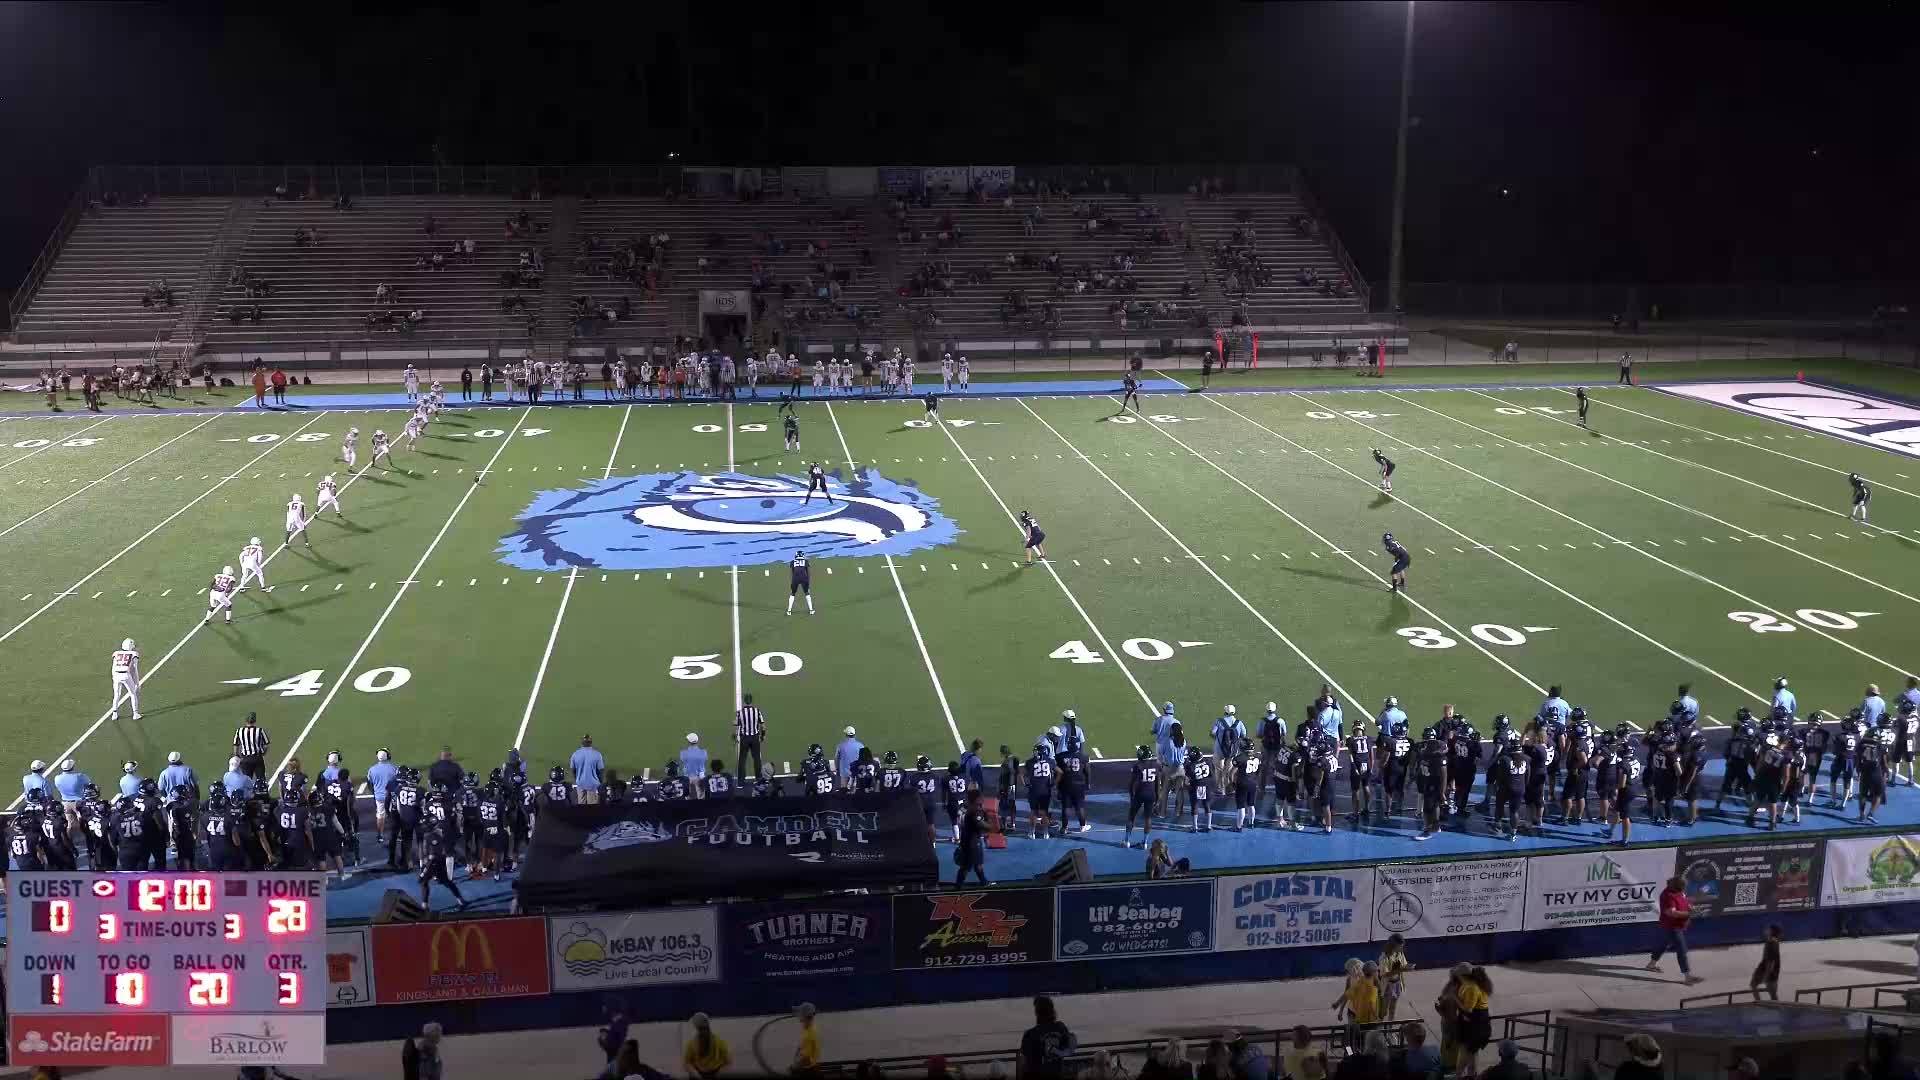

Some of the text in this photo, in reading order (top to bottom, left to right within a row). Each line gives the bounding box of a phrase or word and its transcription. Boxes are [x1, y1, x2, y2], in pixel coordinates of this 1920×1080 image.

[816, 777, 833, 794] 95
[675, 810, 880, 836] CAMDEN
[687, 830, 870, 845] FOOTBALL
[1380, 871, 1522, 886] WESTSIDE BAPTIST CHURCH
[1233, 875, 1356, 908] COASTAL
[1543, 886, 1656, 906] TRY MY GUY
[1117, 904, 1184, 921] Seabag
[1236, 909, 1352, 930] CAR CARE
[748, 912, 868, 944] TURNER
[1092, 920, 1179, 933] 882-6000
[1447, 922, 1498, 933] GO CATS!
[661, 933, 701, 950] 106.3
[783, 936, 835, 946] BROTHERS
[1102, 940, 1116, 952] GO
[763, 950, 810, 963] HEATING
[812, 950, 835, 961] AND
[924, 951, 1028, 967] 912.729.3995
[605, 962, 711, 979] Live Local Country
